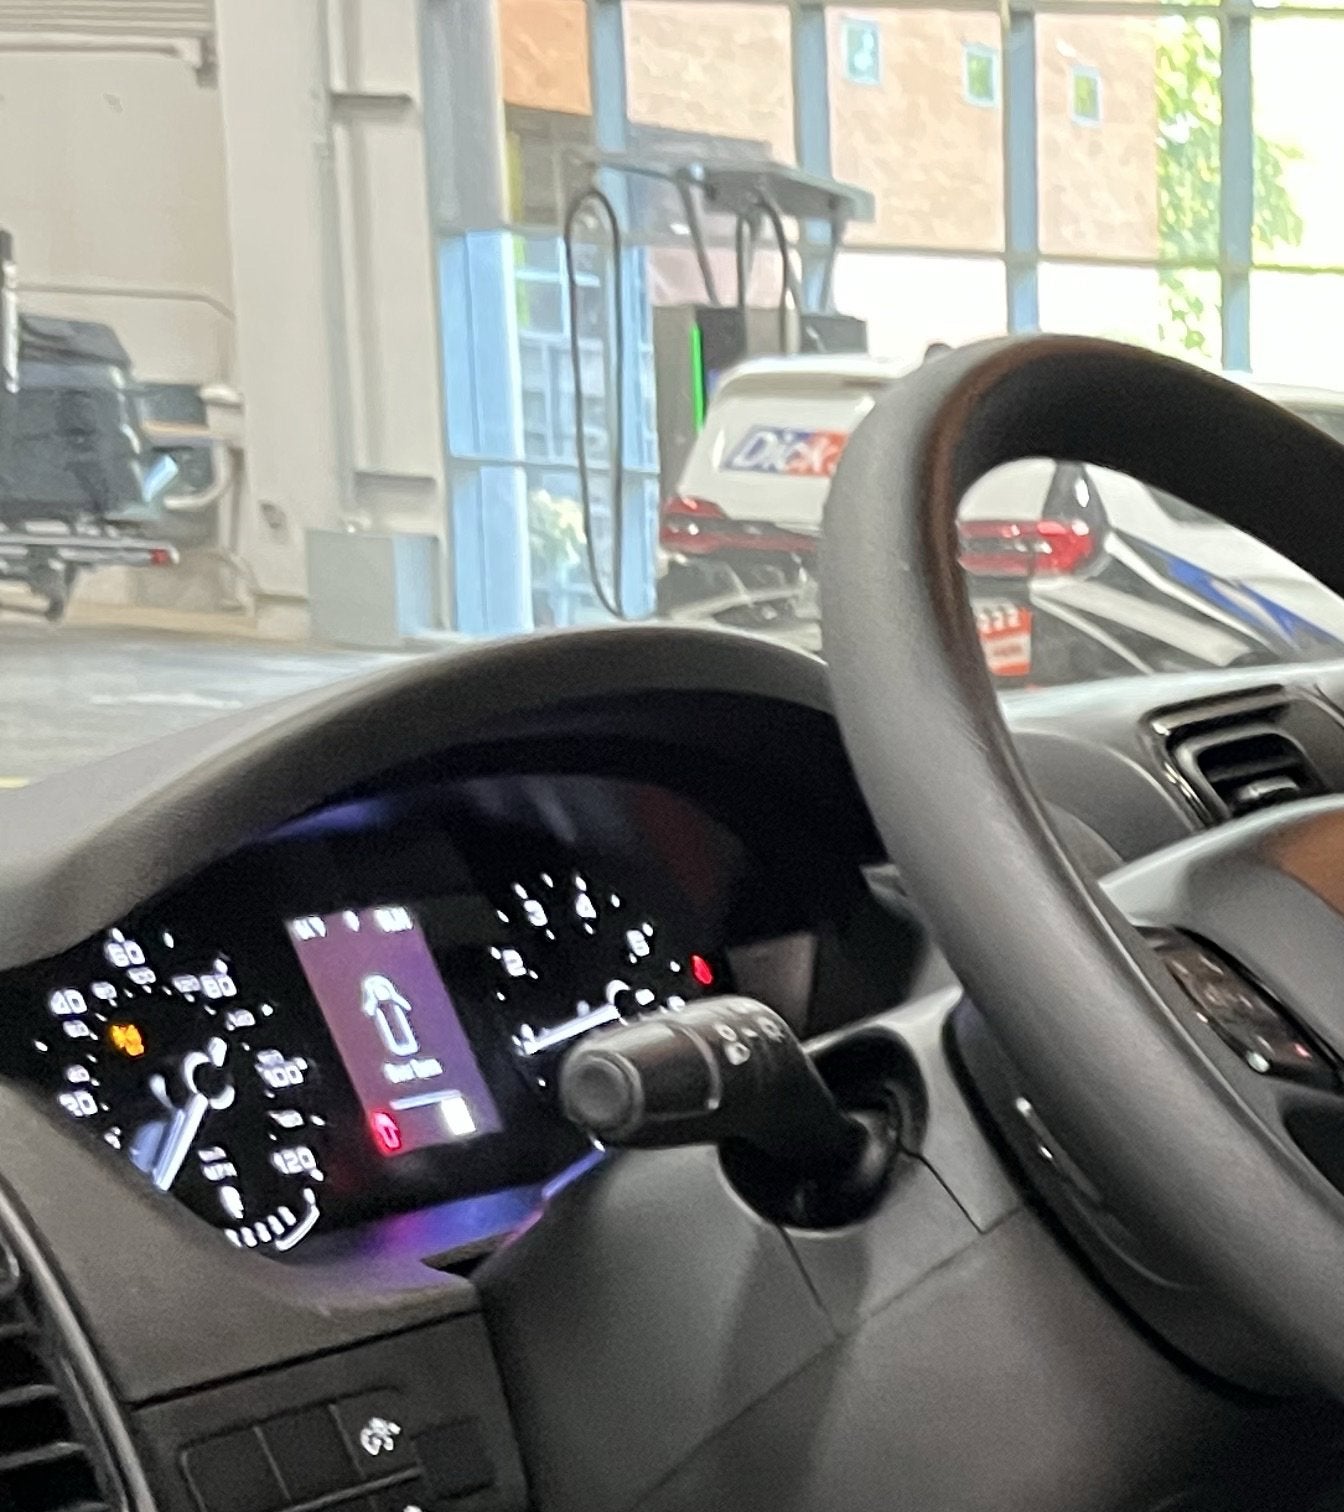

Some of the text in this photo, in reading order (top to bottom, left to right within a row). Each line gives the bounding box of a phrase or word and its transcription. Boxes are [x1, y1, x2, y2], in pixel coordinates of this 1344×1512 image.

[105, 940, 145, 967] 60
[50, 989, 88, 1014] 40
[58, 1090, 98, 1117] 20
[273, 1146, 316, 1174] 120
